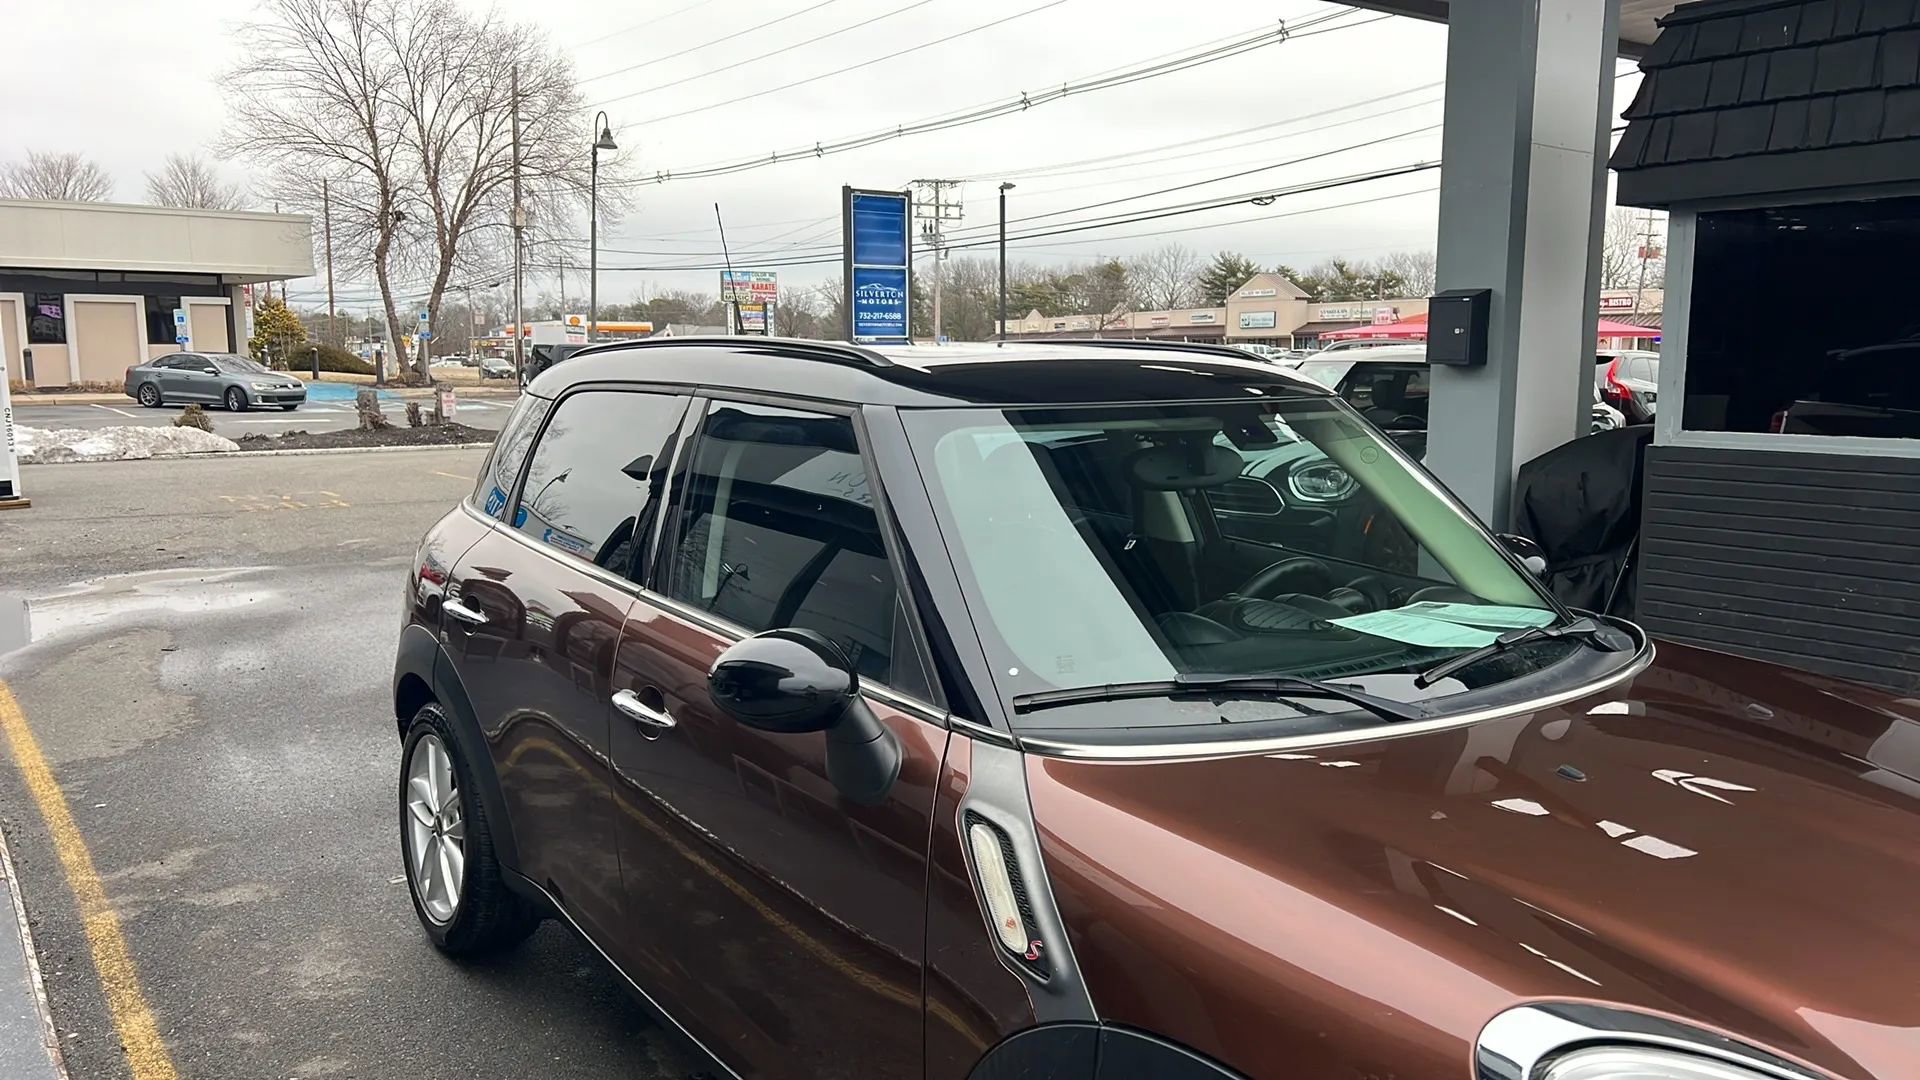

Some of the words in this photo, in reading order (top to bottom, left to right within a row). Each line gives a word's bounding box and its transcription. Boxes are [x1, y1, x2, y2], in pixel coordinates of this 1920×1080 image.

[751, 283, 776, 291] KARATE
[855, 290, 904, 298] SILVERTON
[1024, 940, 1043, 960] S
